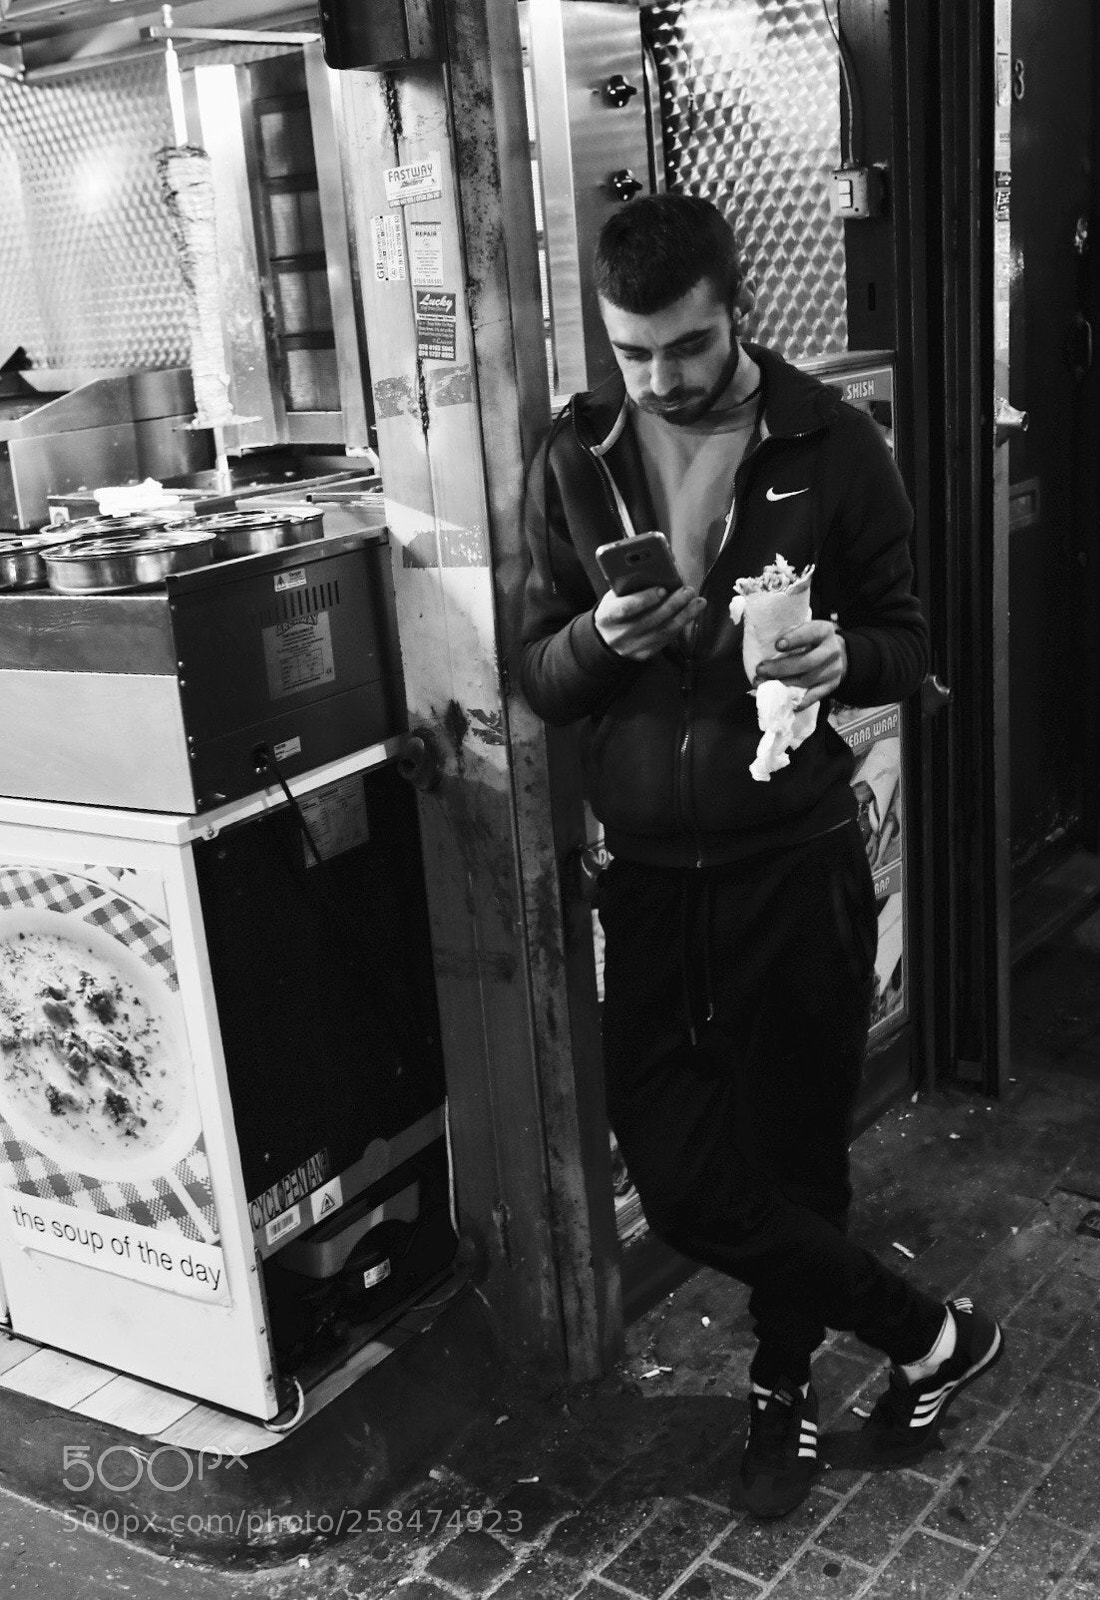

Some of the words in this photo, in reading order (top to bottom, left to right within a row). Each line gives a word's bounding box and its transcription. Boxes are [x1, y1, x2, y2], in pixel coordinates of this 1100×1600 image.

[388, 163, 433, 182] FASTWAY
[376, 262, 385, 279] GB
[419, 293, 453, 313] Lucky
[846, 379, 875, 400] SHISH
[873, 713, 898, 736] WRAP
[874, 876, 890, 895] RAP
[12, 1205, 46, 1232] the
[51, 1220, 104, 1253] soup
[111, 1235, 131, 1258] of
[137, 1240, 173, 1271] the
[180, 1255, 221, 1291] day
